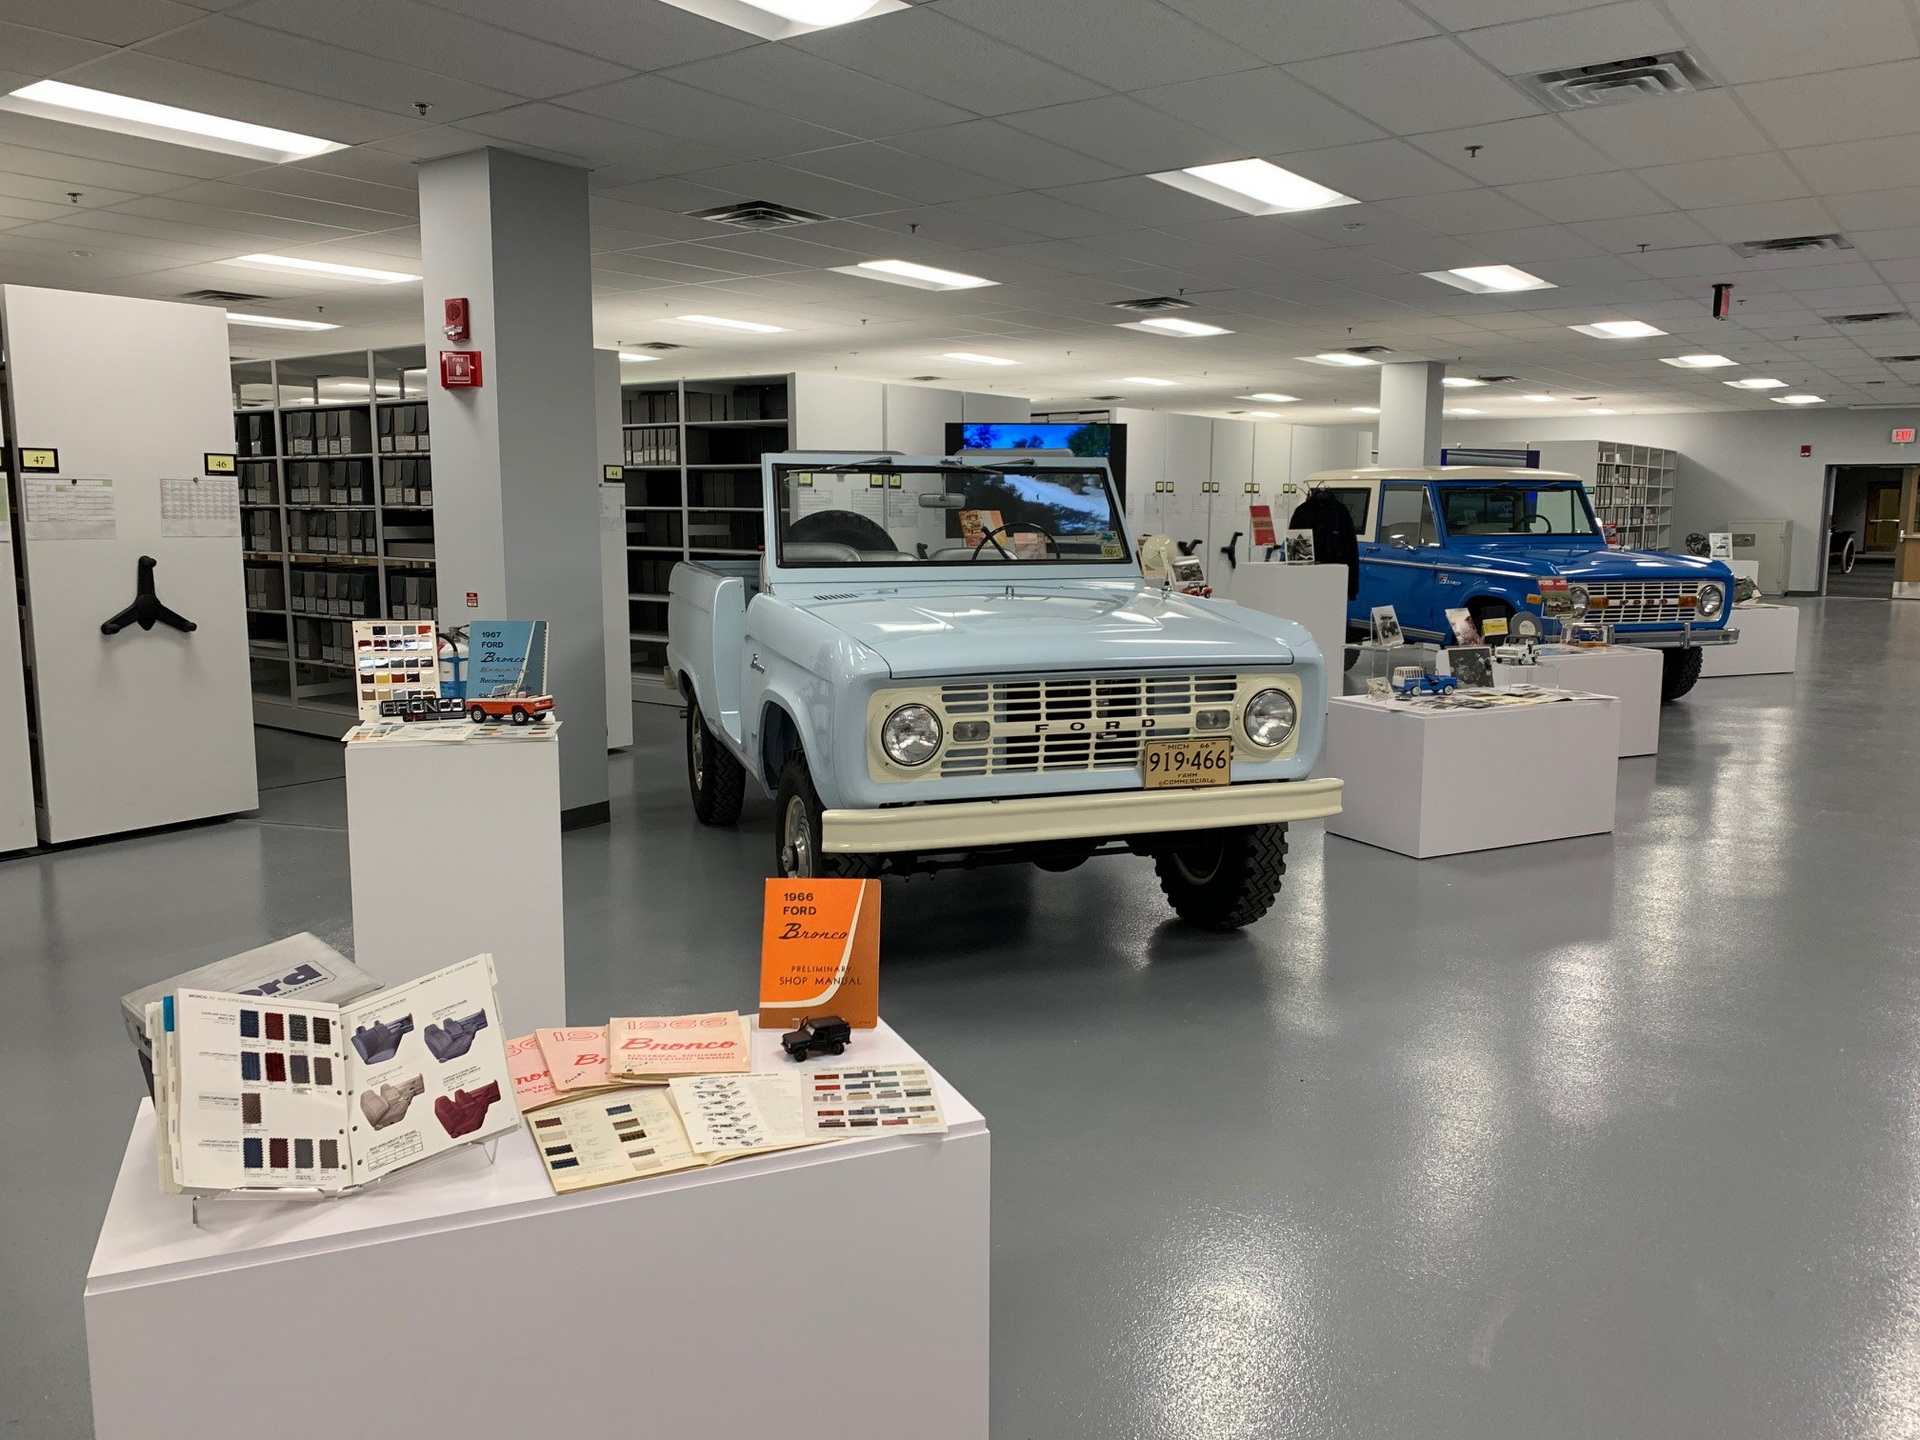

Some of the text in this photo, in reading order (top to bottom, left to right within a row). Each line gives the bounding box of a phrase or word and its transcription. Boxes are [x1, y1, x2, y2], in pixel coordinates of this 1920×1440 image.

[33, 456, 45, 464] 47
[216, 460, 227, 469] 46
[481, 631, 502, 639] 1967
[481, 641, 504, 649] FORD
[480, 651, 526, 664] Bronco
[382, 698, 464, 715] BRONCO
[1034, 718, 1156, 733] FORD
[1163, 777, 1212, 786] COMMERCIAL
[783, 892, 815, 902] 1966
[782, 905, 817, 916] FORD
[777, 922, 850, 940] Bronco
[790, 965, 853, 973] PRELIMINARY
[778, 976, 863, 986] SHOP MANUAL
[627, 1017, 728, 1031] 1966
[619, 1037, 739, 1051] Bronco
